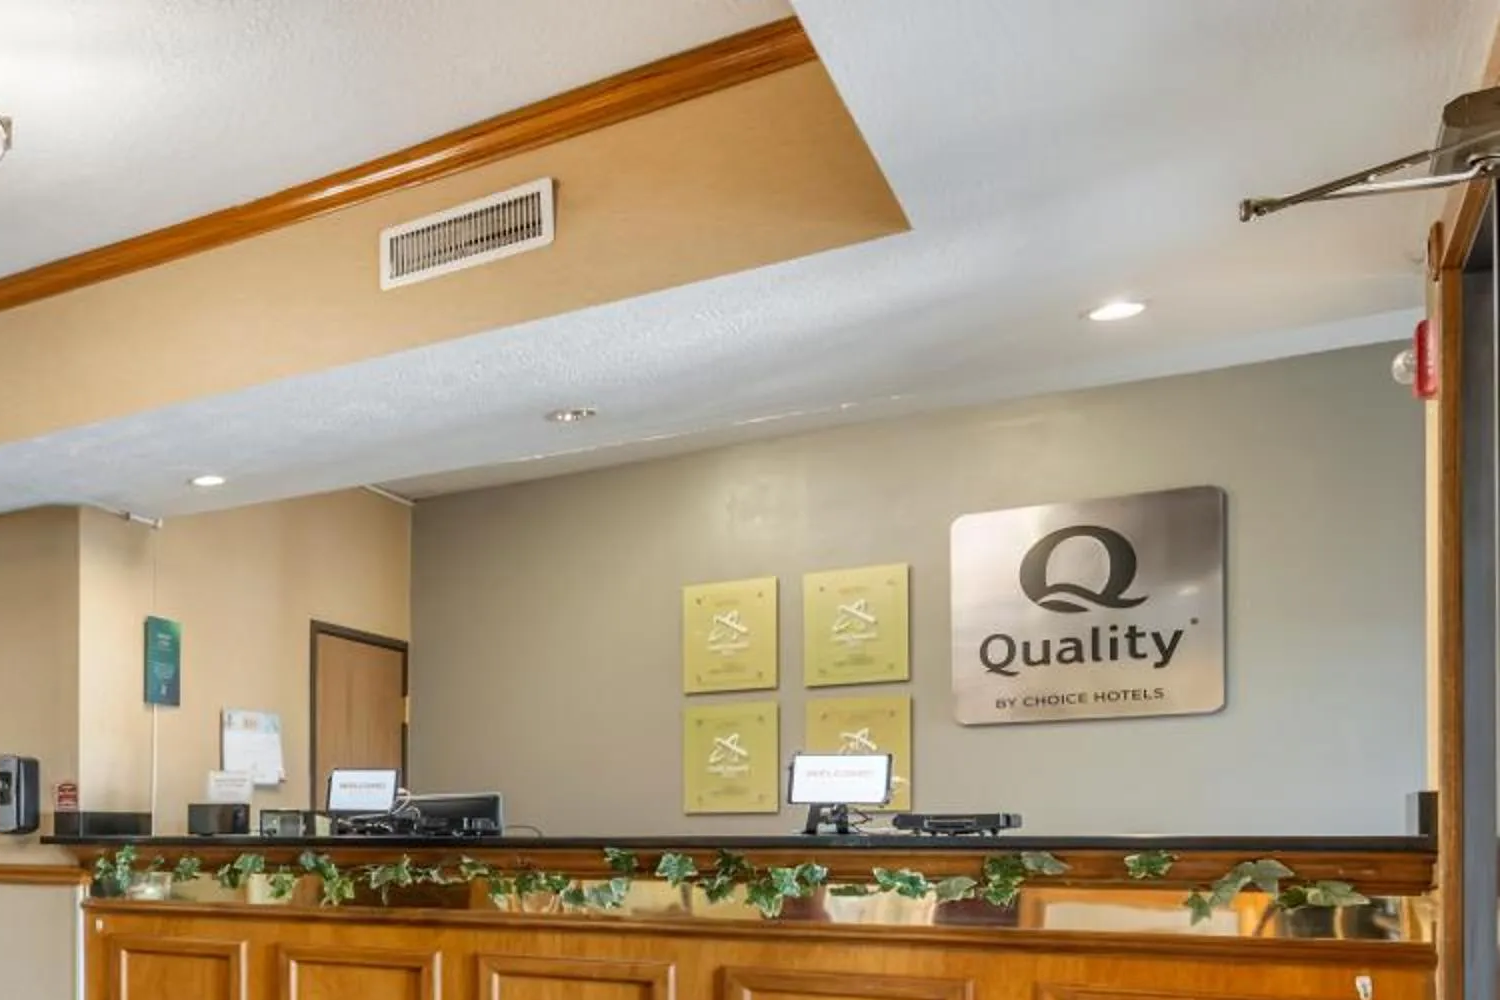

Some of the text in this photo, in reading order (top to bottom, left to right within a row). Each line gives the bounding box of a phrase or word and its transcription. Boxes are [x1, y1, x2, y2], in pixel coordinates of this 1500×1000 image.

[1018, 525, 1149, 613] Q
[979, 624, 1184, 677] Quality
[995, 687, 1165, 710] BY CHOICE HOTELS
